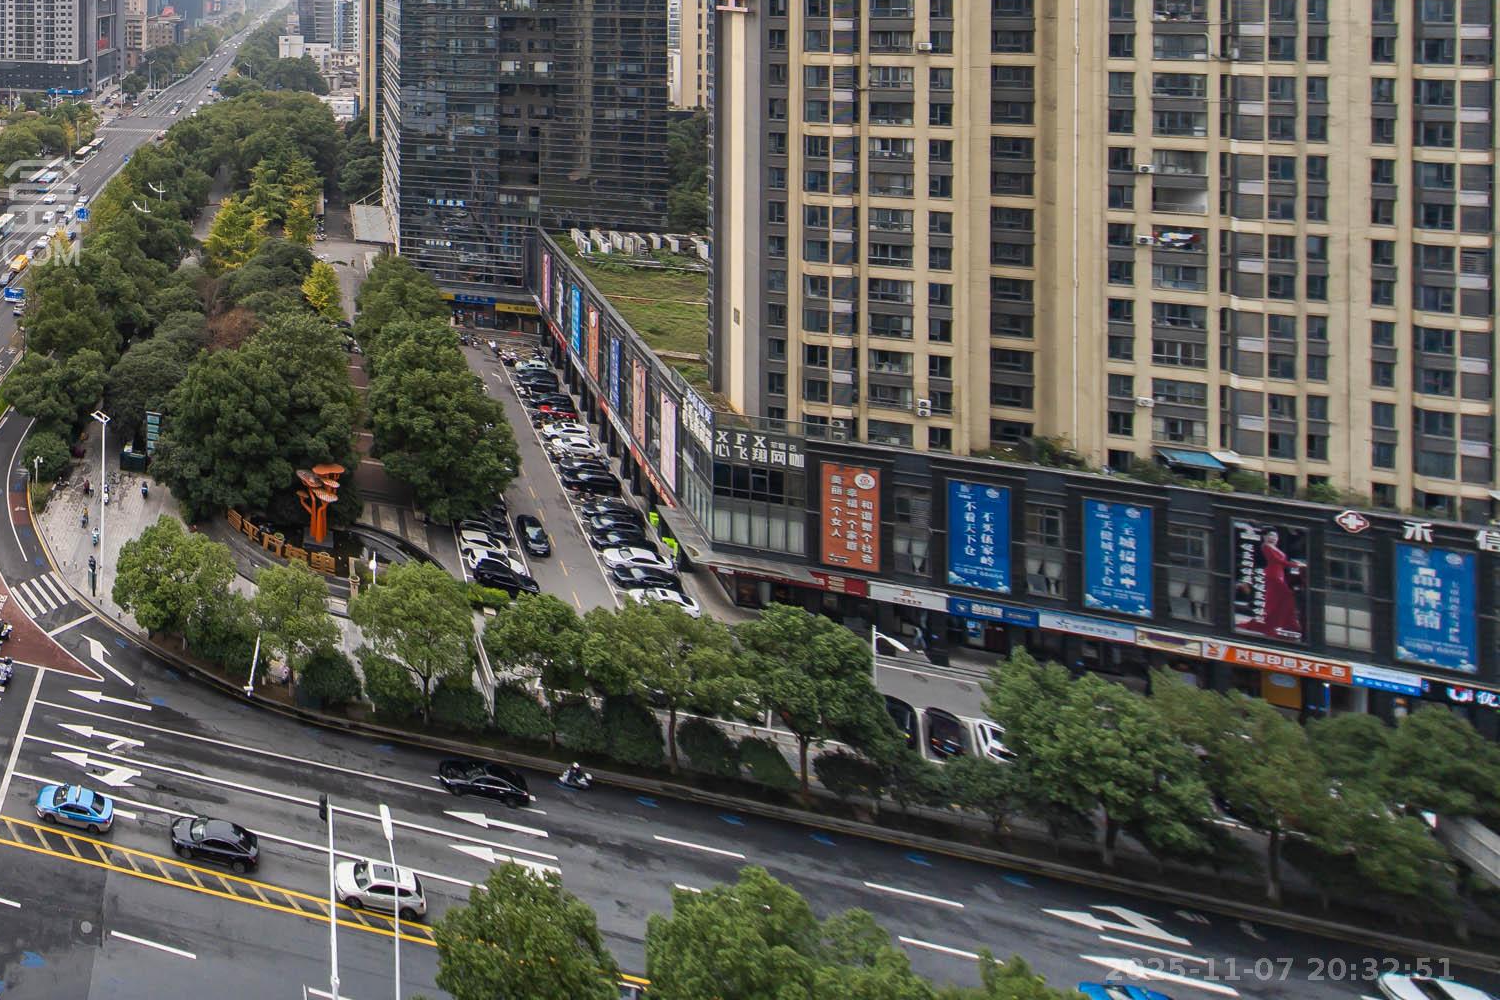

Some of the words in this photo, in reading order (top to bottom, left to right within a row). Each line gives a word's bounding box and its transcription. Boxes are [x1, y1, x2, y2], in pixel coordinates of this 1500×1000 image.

[716, 430, 766, 448] XFX
[715, 443, 805, 468] 心飞翔网咖
[830, 474, 843, 538] 美丽一个女人
